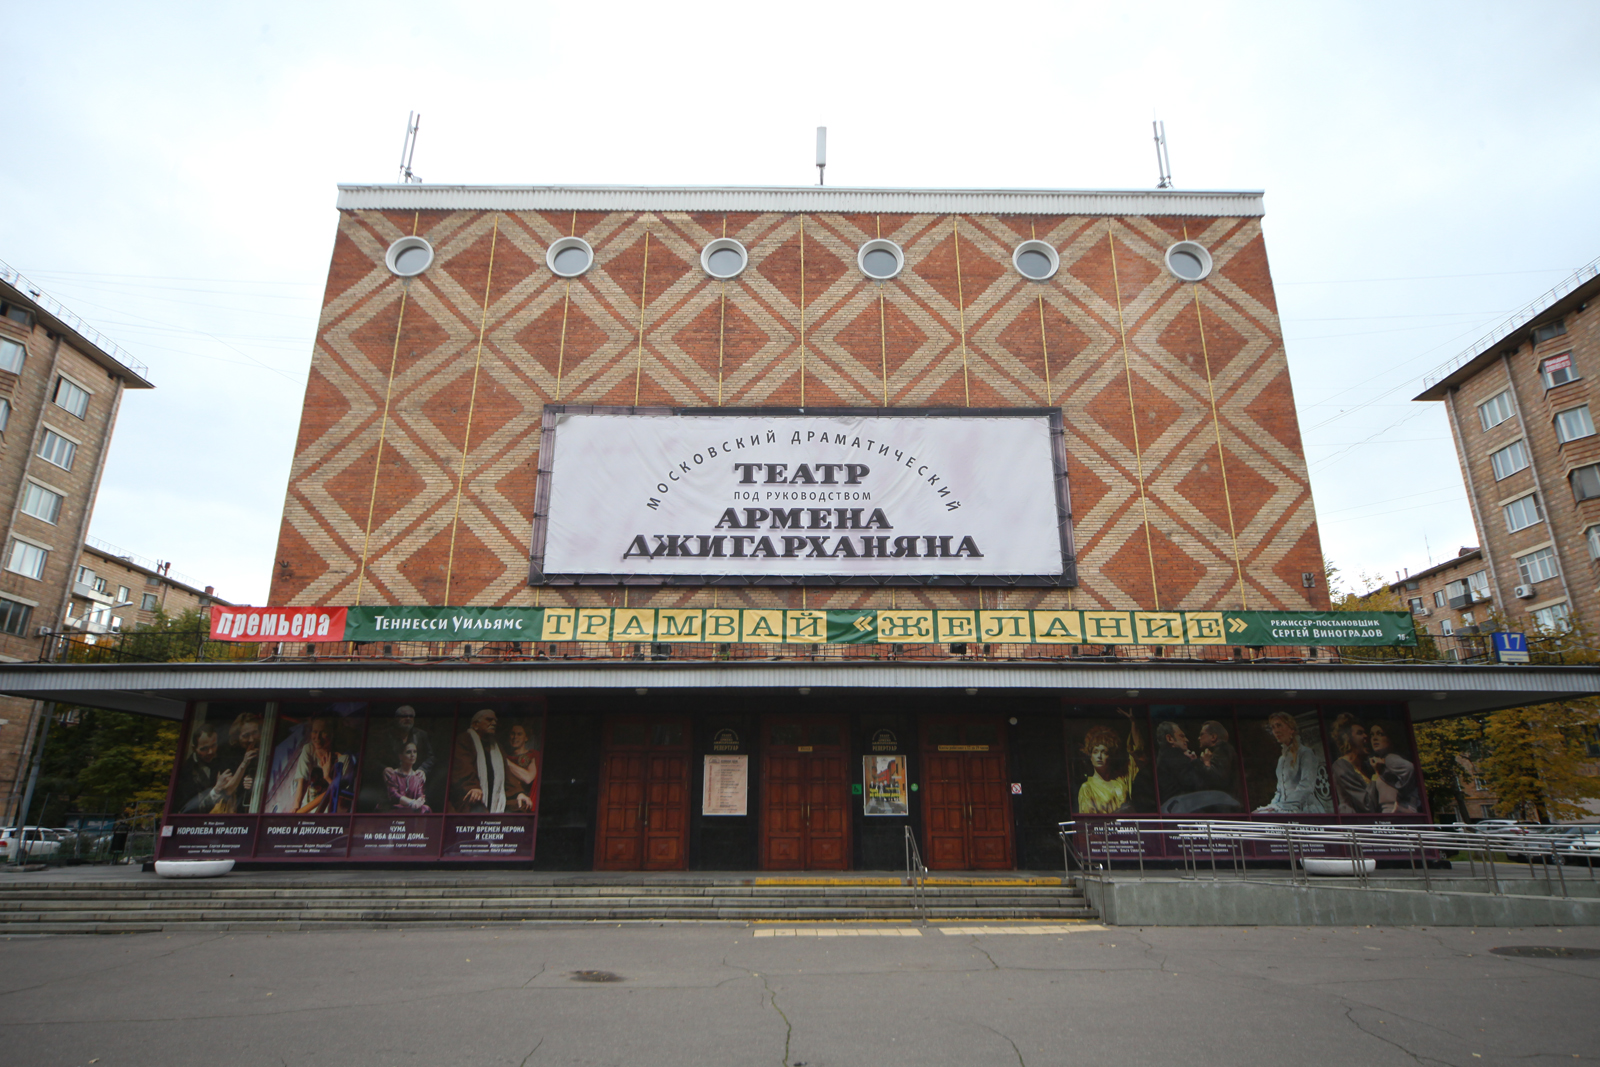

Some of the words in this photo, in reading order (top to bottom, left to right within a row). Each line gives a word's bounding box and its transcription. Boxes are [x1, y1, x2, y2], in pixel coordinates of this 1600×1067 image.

[647, 430, 777, 511] МОСКОВСКИЙ
[791, 430, 961, 513] ДРАМАТИЧЕСКИЙ
[734, 463, 871, 485] ТЕАТР
[734, 491, 762, 501] ПОД
[766, 490, 872, 502] РУКОВОДСТВОМ
[714, 507, 894, 529] АРМЕНА
[622, 534, 984, 560] ДЖИГАРХАНЯНА
[216, 611, 331, 638] премьера
[546, 612, 824, 638] ТРАМВАЙ
[1501, 633, 1521, 650] 17
[177, 826, 213, 835] КОРОЛЕВА
[215, 826, 249, 835] КРАСОТЫ
[267, 826, 291, 835] РОМЕО
[293, 826, 298, 834] И
[299, 826, 344, 836] ДЖУЛЬЕТТА
[455, 825, 474, 833] ТЕАТР
